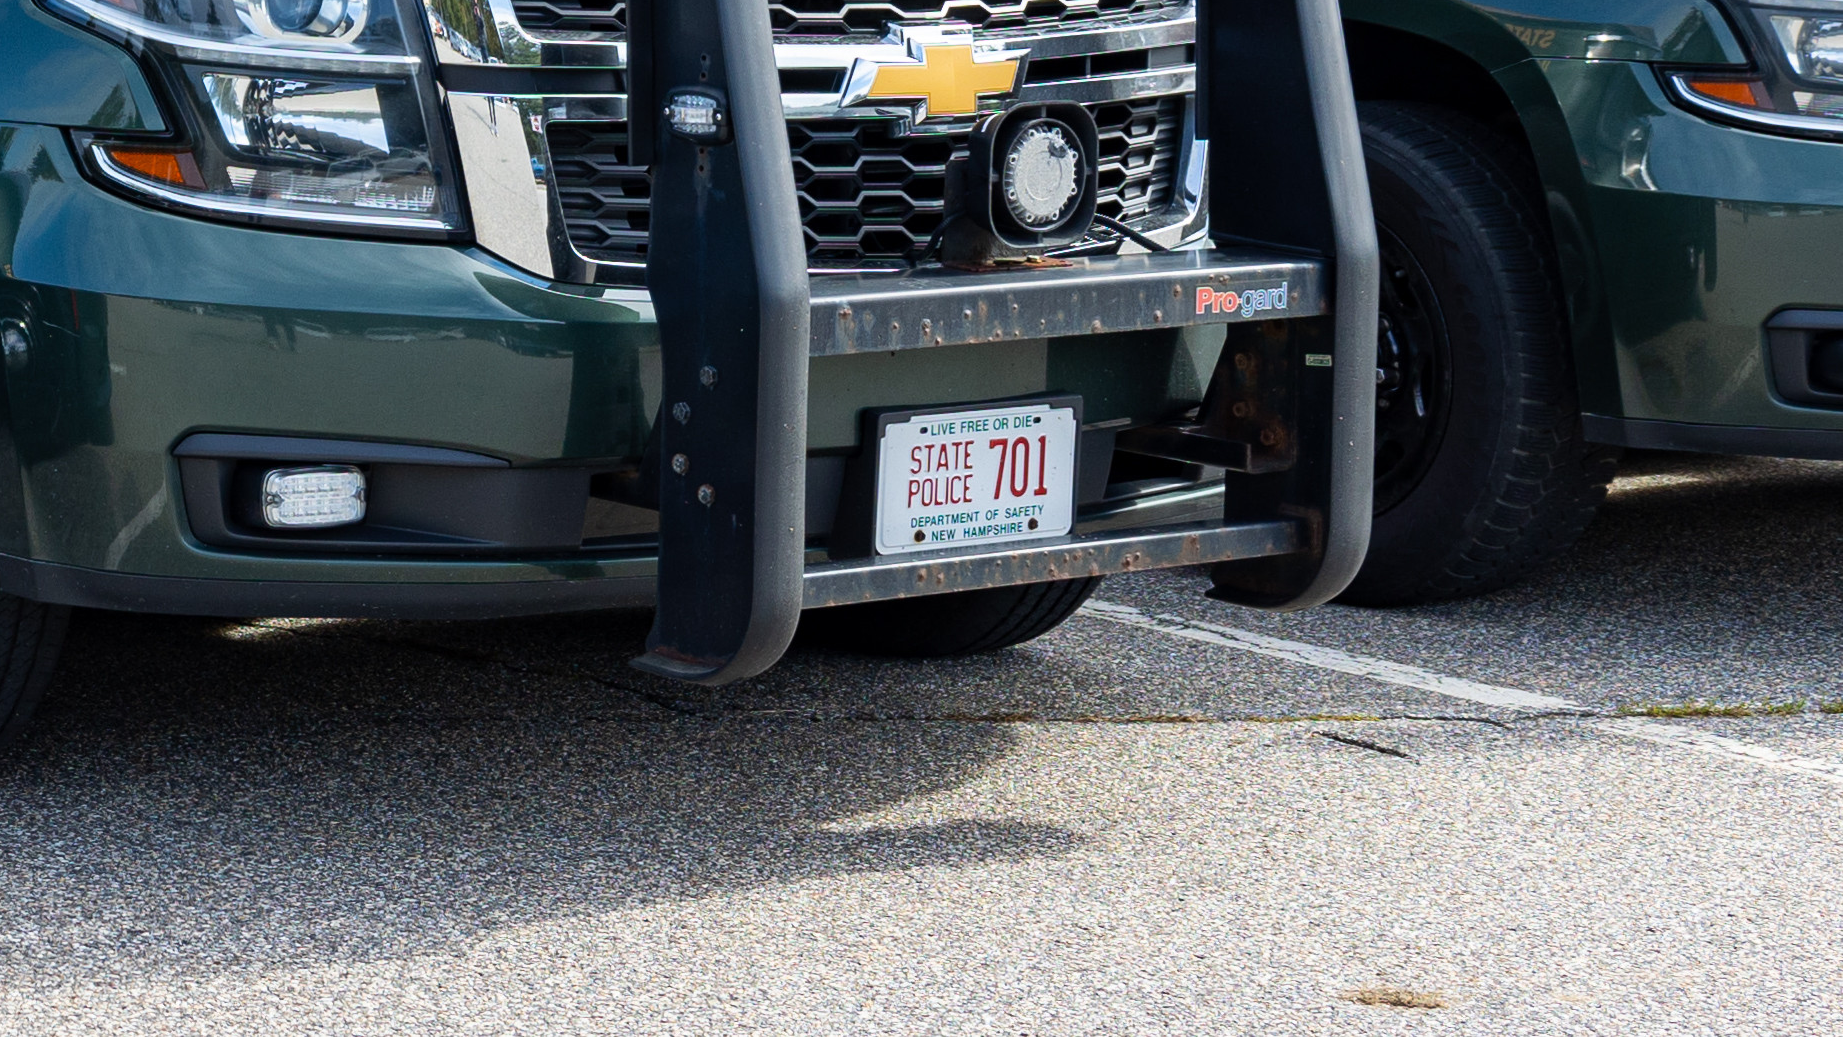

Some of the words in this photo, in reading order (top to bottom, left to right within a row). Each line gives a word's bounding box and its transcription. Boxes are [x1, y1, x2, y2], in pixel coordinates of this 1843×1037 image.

[930, 423, 956, 436] LIVE
[960, 419, 989, 433] FREE
[993, 417, 1009, 430] OR
[1013, 415, 1033, 429] DIE
[910, 440, 974, 474] STATE
[989, 435, 1047, 500] 701
[908, 474, 973, 508] POLICE
[910, 511, 979, 528] DEPARTMENT
[985, 509, 999, 521] OF
[1004, 505, 1044, 519] SAFETY
[931, 529, 956, 541] NEW
[963, 521, 1023, 539] HAMPSHIRE
